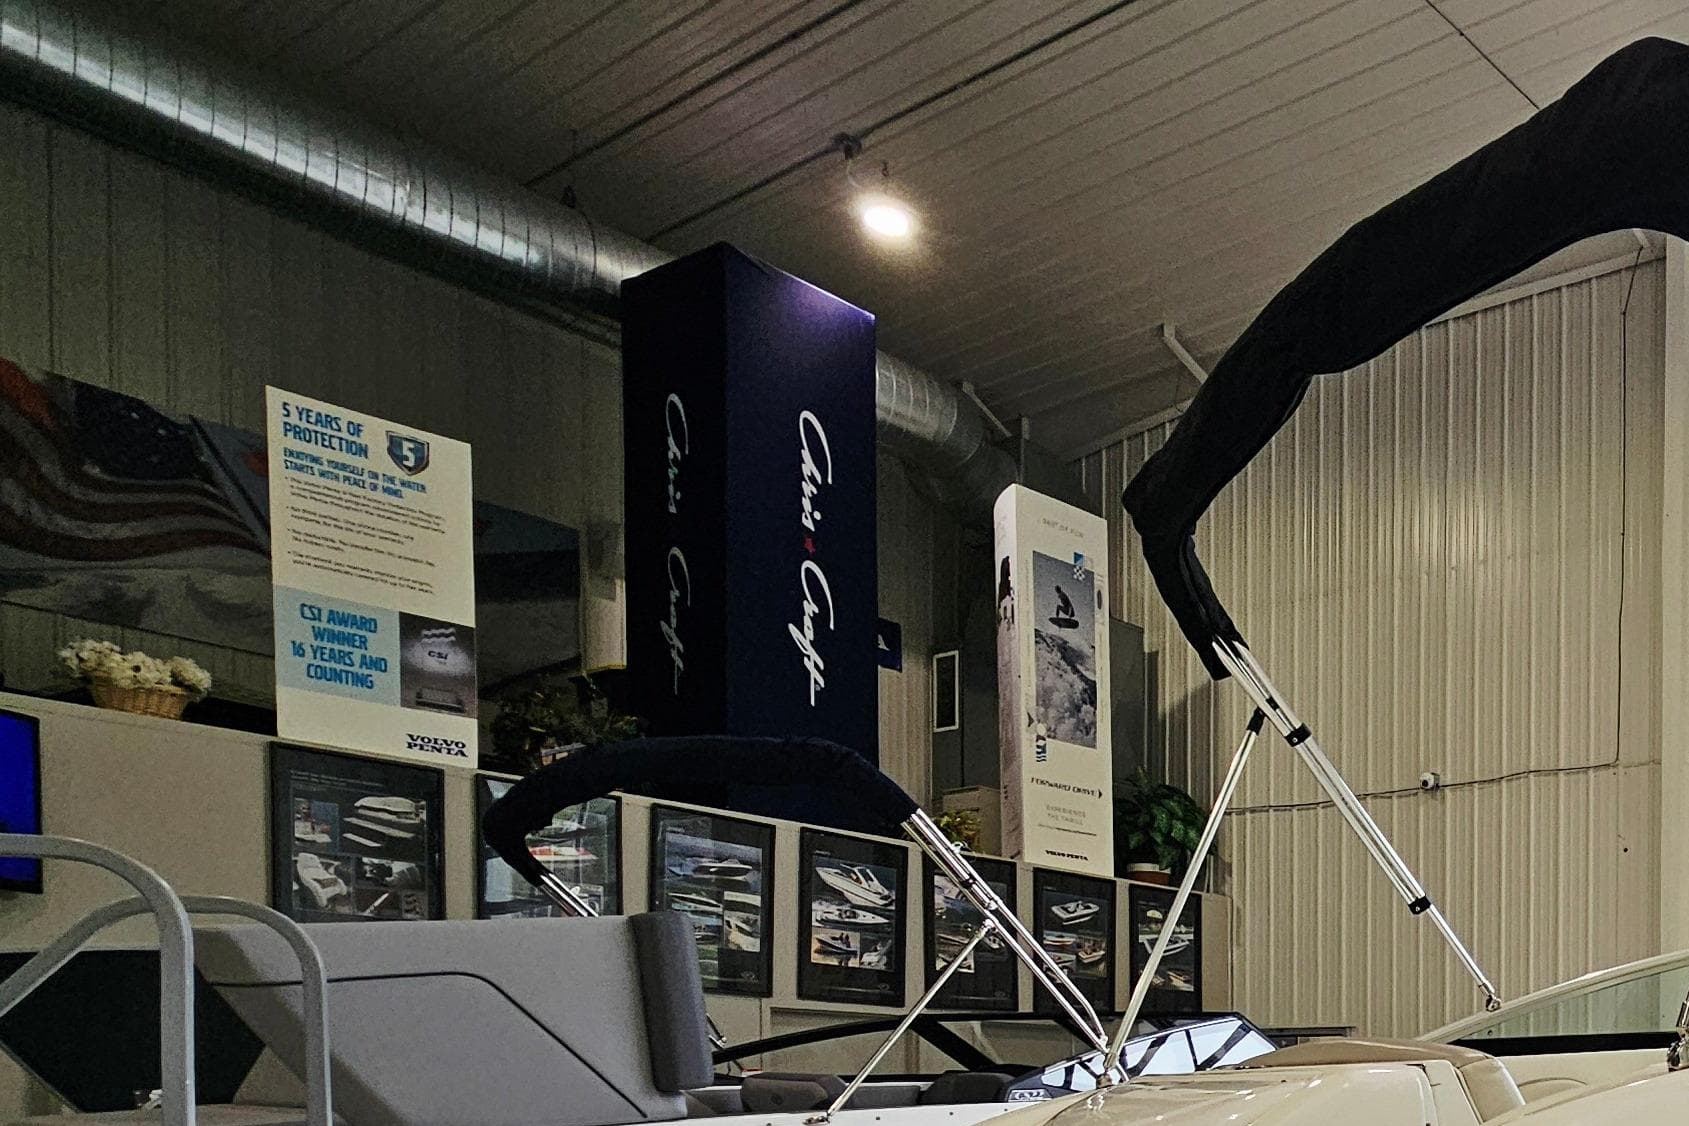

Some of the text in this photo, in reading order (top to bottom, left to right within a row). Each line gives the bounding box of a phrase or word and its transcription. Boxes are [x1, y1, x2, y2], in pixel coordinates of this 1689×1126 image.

[282, 401, 365, 438] 5 YEARS OF
[283, 421, 369, 459] PROTECTION
[402, 441, 416, 468] 5
[283, 460, 316, 476] STARTS
[318, 468, 340, 483] WITH
[342, 474, 367, 490] PEACE
[369, 482, 379, 492] OF
[326, 459, 366, 477] YOURSELF
[367, 470, 380, 481] ON
[382, 473, 398, 486] THE
[399, 478, 427, 494] WATER
[787, 409, 835, 707] Chris Craft
[300, 602, 378, 634] CSI AWARD
[312, 625, 368, 651] WINNER
[290, 640, 388, 674] 16 YEARS AND
[306, 663, 375, 690] COUNTING
[406, 733, 467, 749] VOLVO
[406, 741, 468, 758] PENTA
